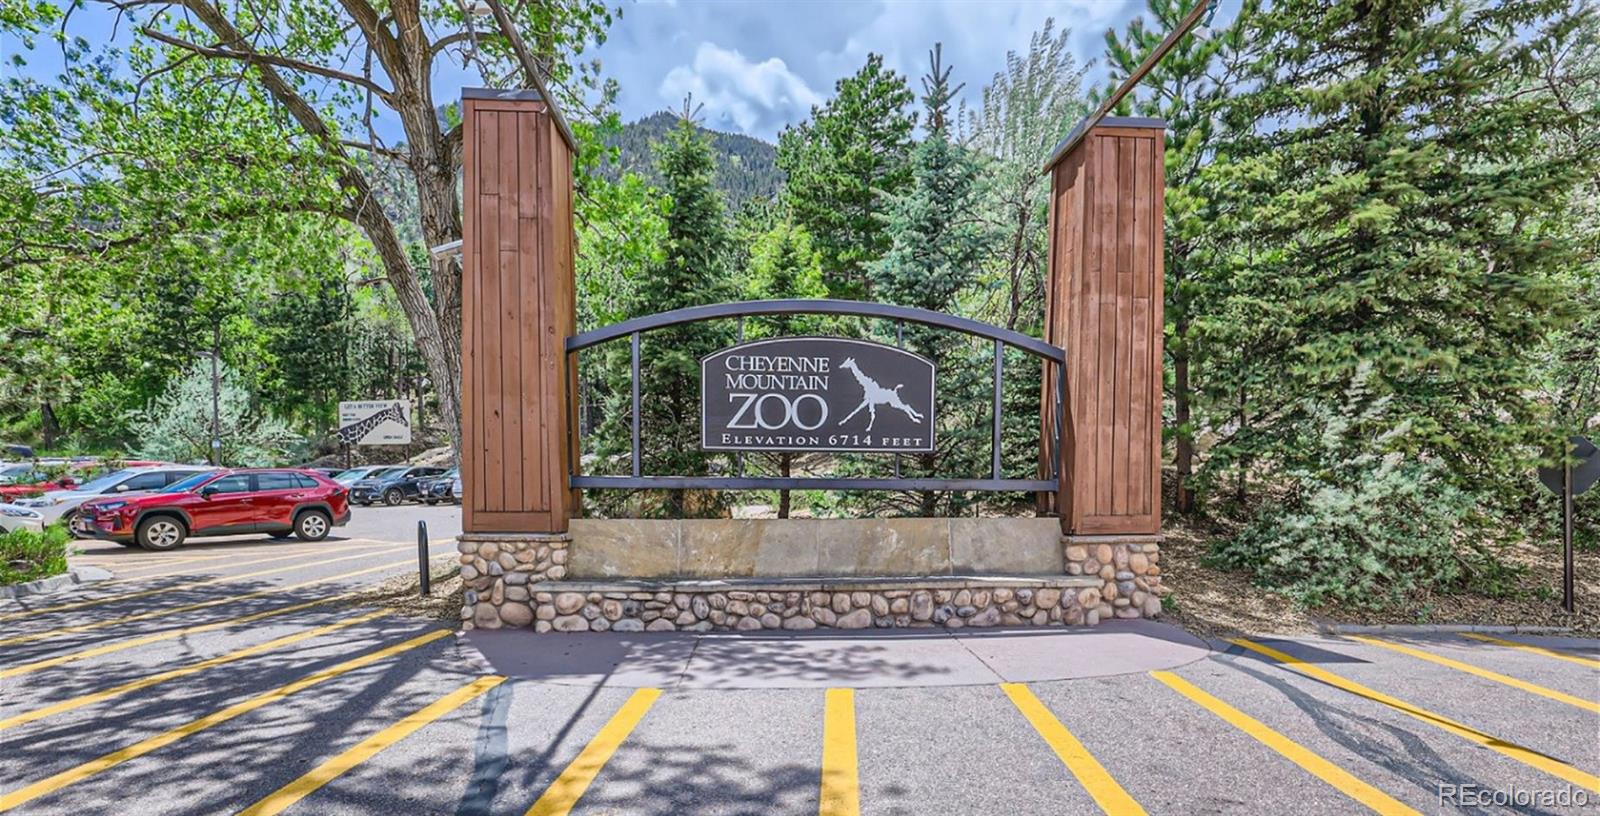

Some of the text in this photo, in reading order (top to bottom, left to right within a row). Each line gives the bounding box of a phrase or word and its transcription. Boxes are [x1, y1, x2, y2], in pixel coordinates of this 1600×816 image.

[725, 356, 829, 373] CHEYENNE
[725, 374, 828, 390] MOUNTAIN
[726, 393, 828, 430] ZOO
[829, 434, 872, 446] 6714
[882, 438, 922, 446] FEET
